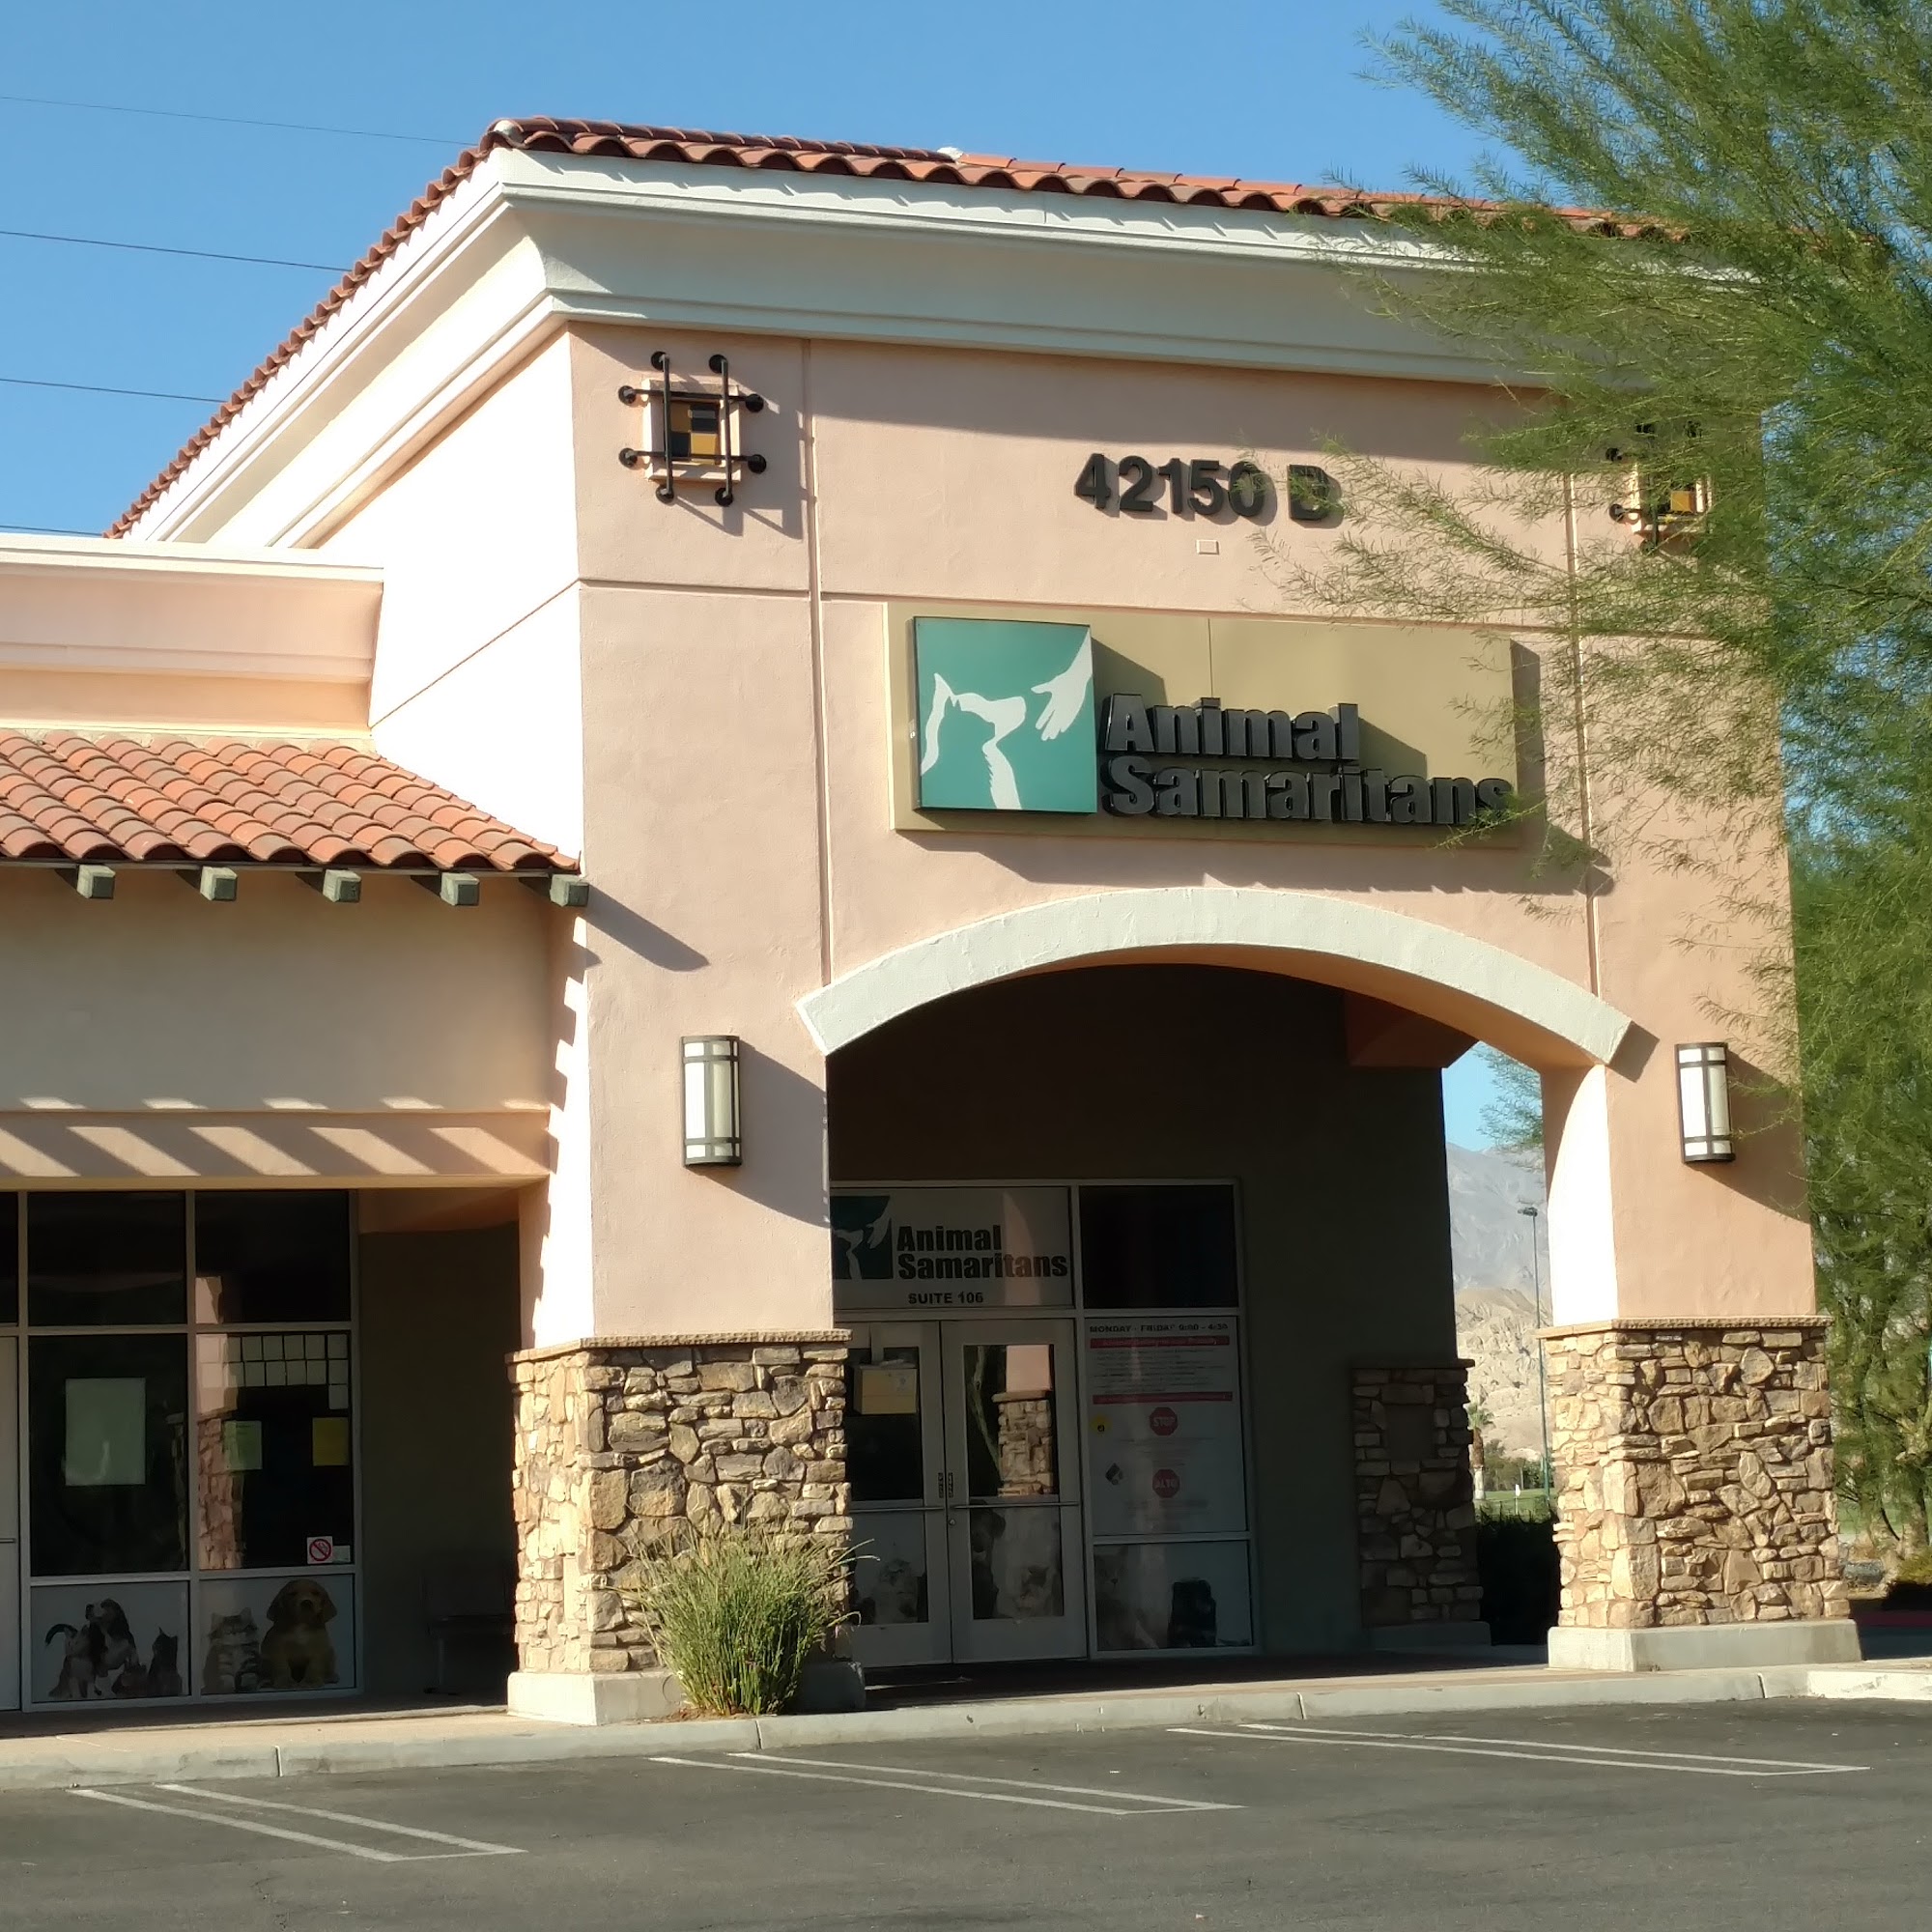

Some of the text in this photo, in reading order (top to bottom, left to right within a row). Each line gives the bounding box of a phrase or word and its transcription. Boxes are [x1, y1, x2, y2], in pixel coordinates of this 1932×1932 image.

[1074, 453, 1265, 518] 42150
[1104, 693, 1359, 761] Animal
[1102, 755, 1514, 825] Samaritans
[896, 1224, 1003, 1252] Animal
[897, 1253, 1068, 1280] Samaritans
[908, 1291, 983, 1304] SUITE 106
[1153, 1416, 1175, 1427] STOP
